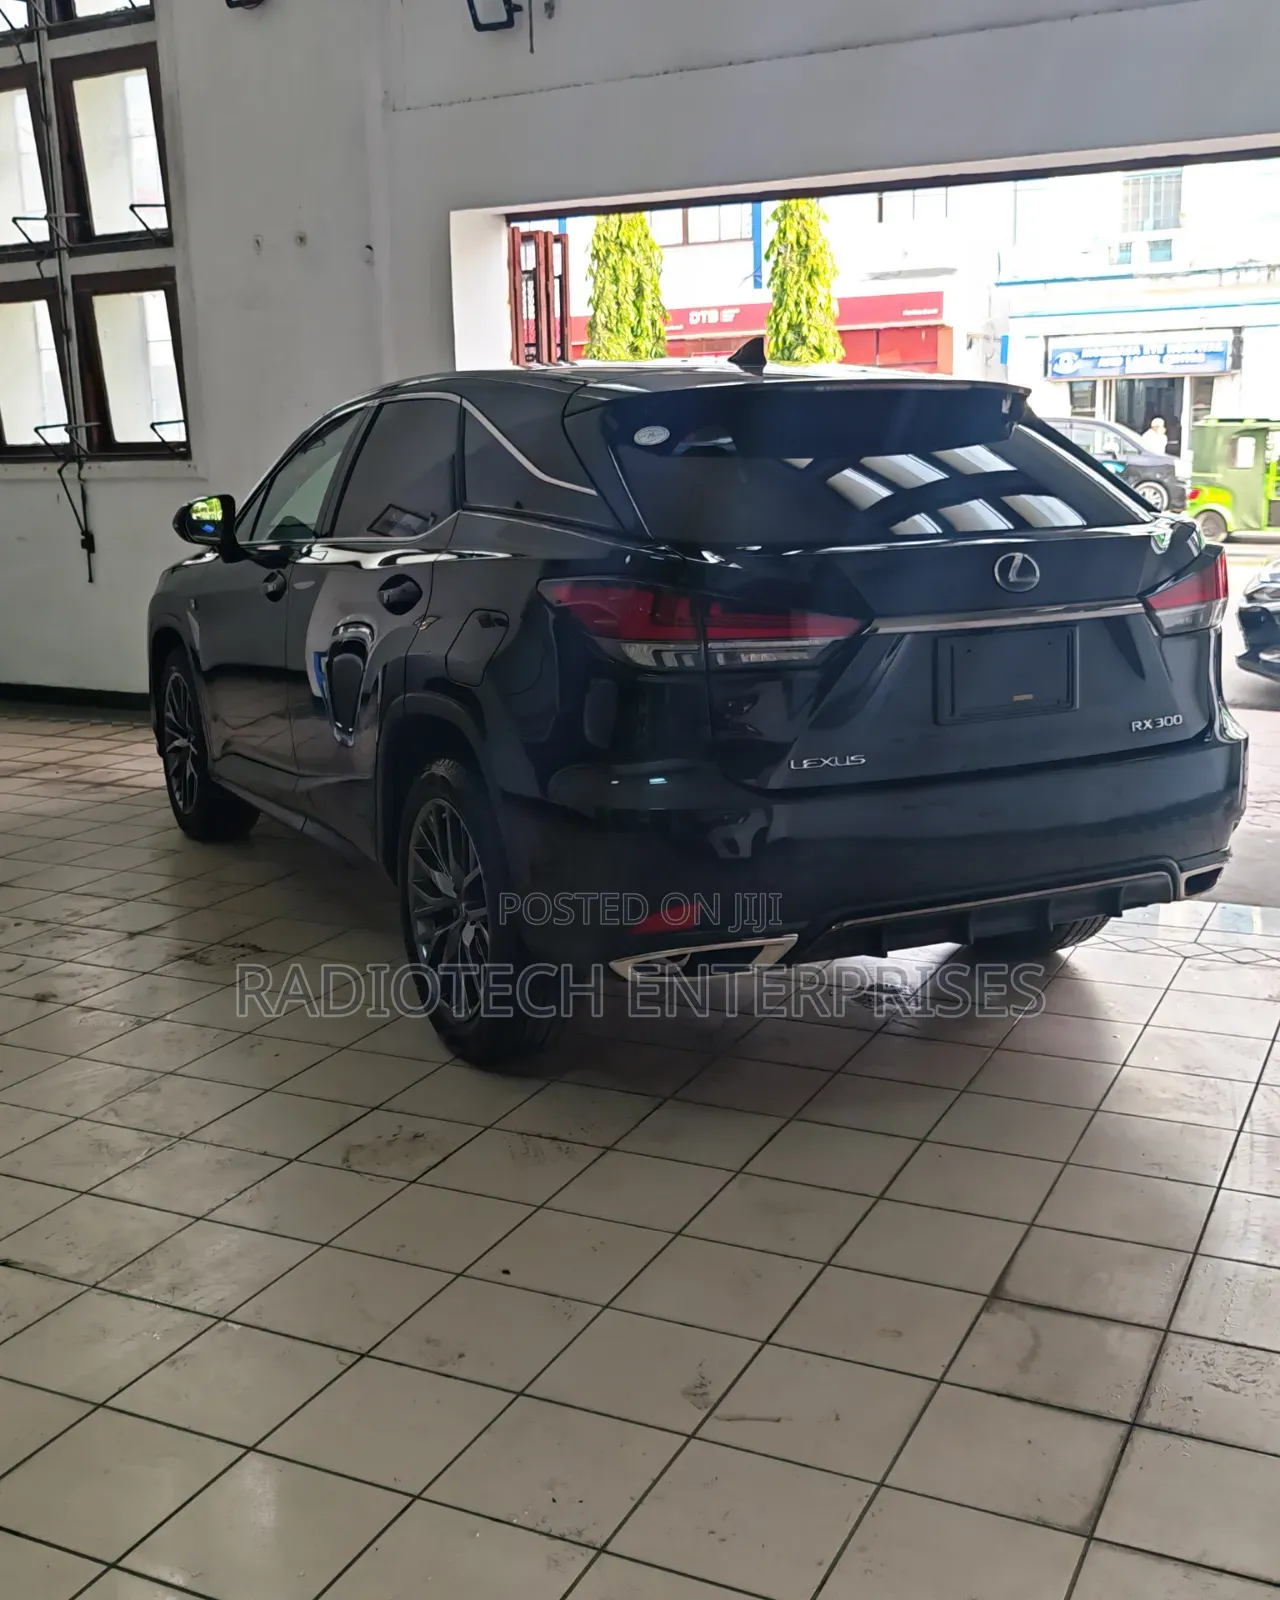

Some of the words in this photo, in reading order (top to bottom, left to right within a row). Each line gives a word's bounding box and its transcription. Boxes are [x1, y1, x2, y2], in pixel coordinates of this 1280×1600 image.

[1131, 719, 1153, 732] RX
[1154, 714, 1183, 729] 300
[790, 754, 866, 770] LEXUS
